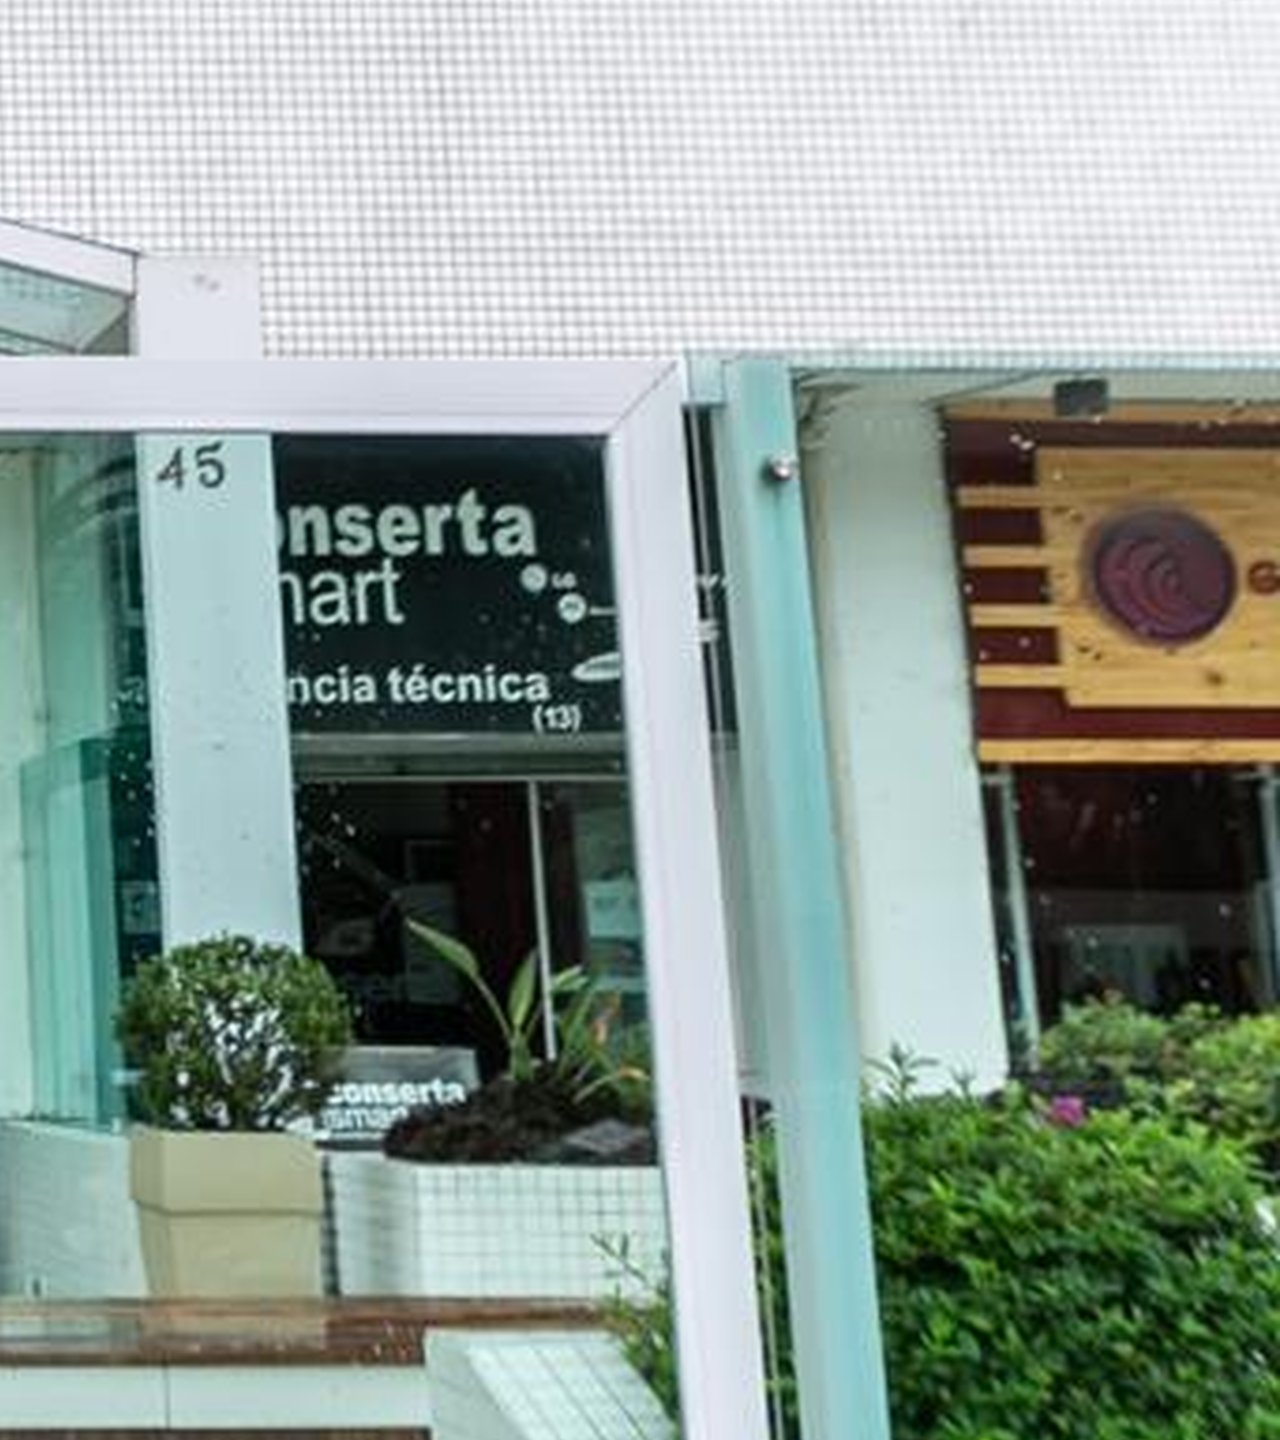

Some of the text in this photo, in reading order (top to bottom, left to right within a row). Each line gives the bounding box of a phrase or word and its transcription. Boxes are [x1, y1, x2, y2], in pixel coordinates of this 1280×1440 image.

[157, 441, 226, 491] 45
[276, 488, 537, 557] nserta
[280, 557, 406, 625] art
[286, 664, 551, 705] ncia técnica
